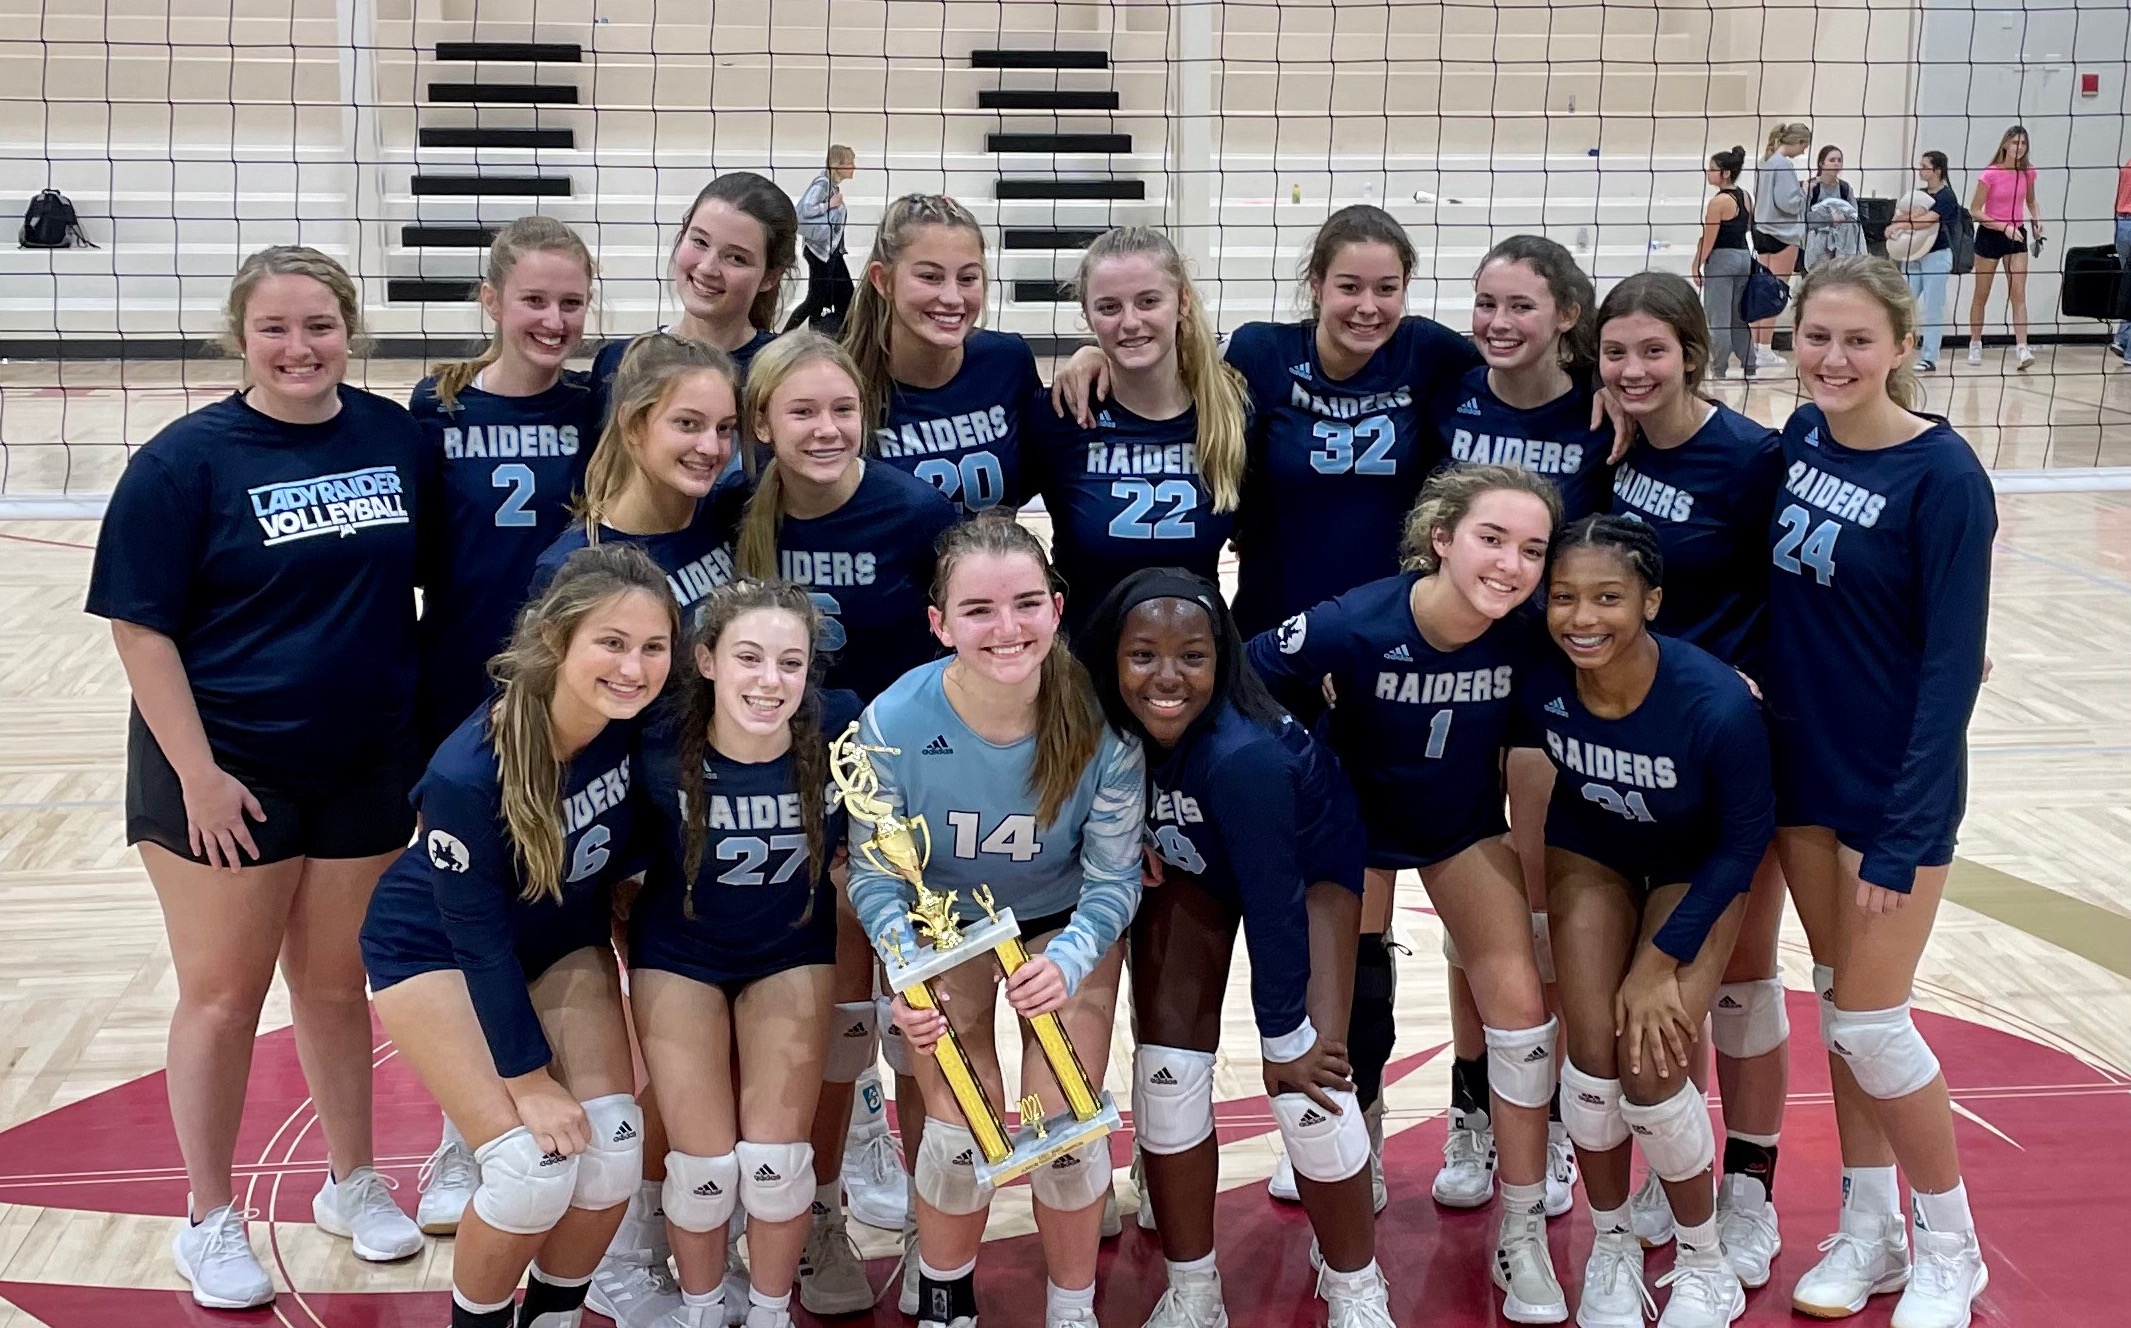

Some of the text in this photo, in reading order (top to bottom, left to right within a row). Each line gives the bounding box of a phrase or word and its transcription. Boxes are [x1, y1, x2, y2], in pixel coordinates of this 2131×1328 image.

[1291, 381, 1412, 419] RAIDERS
[443, 425, 580, 459] RAIDERS
[875, 405, 1008, 458] RAIDERS
[1310, 414, 1397, 475] 32
[1451, 428, 1583, 474] RAIDERS
[1086, 442, 1199, 474] RAIDER
[258, 494, 408, 539] VOLLEYBALL
[492, 463, 537, 527] 2
[1108, 476, 1198, 540] 22
[1785, 460, 1887, 529] RAIDERS
[781, 549, 877, 586] IDERS
[1773, 503, 1842, 588] 24
[1375, 665, 1513, 704] RAIDERS
[1424, 709, 1453, 759] 1
[1546, 728, 1678, 789] RAIDERS
[677, 780, 842, 830] AIDES
[566, 824, 611, 882] 6
[716, 833, 811, 885] 27
[947, 810, 1043, 863] 14
